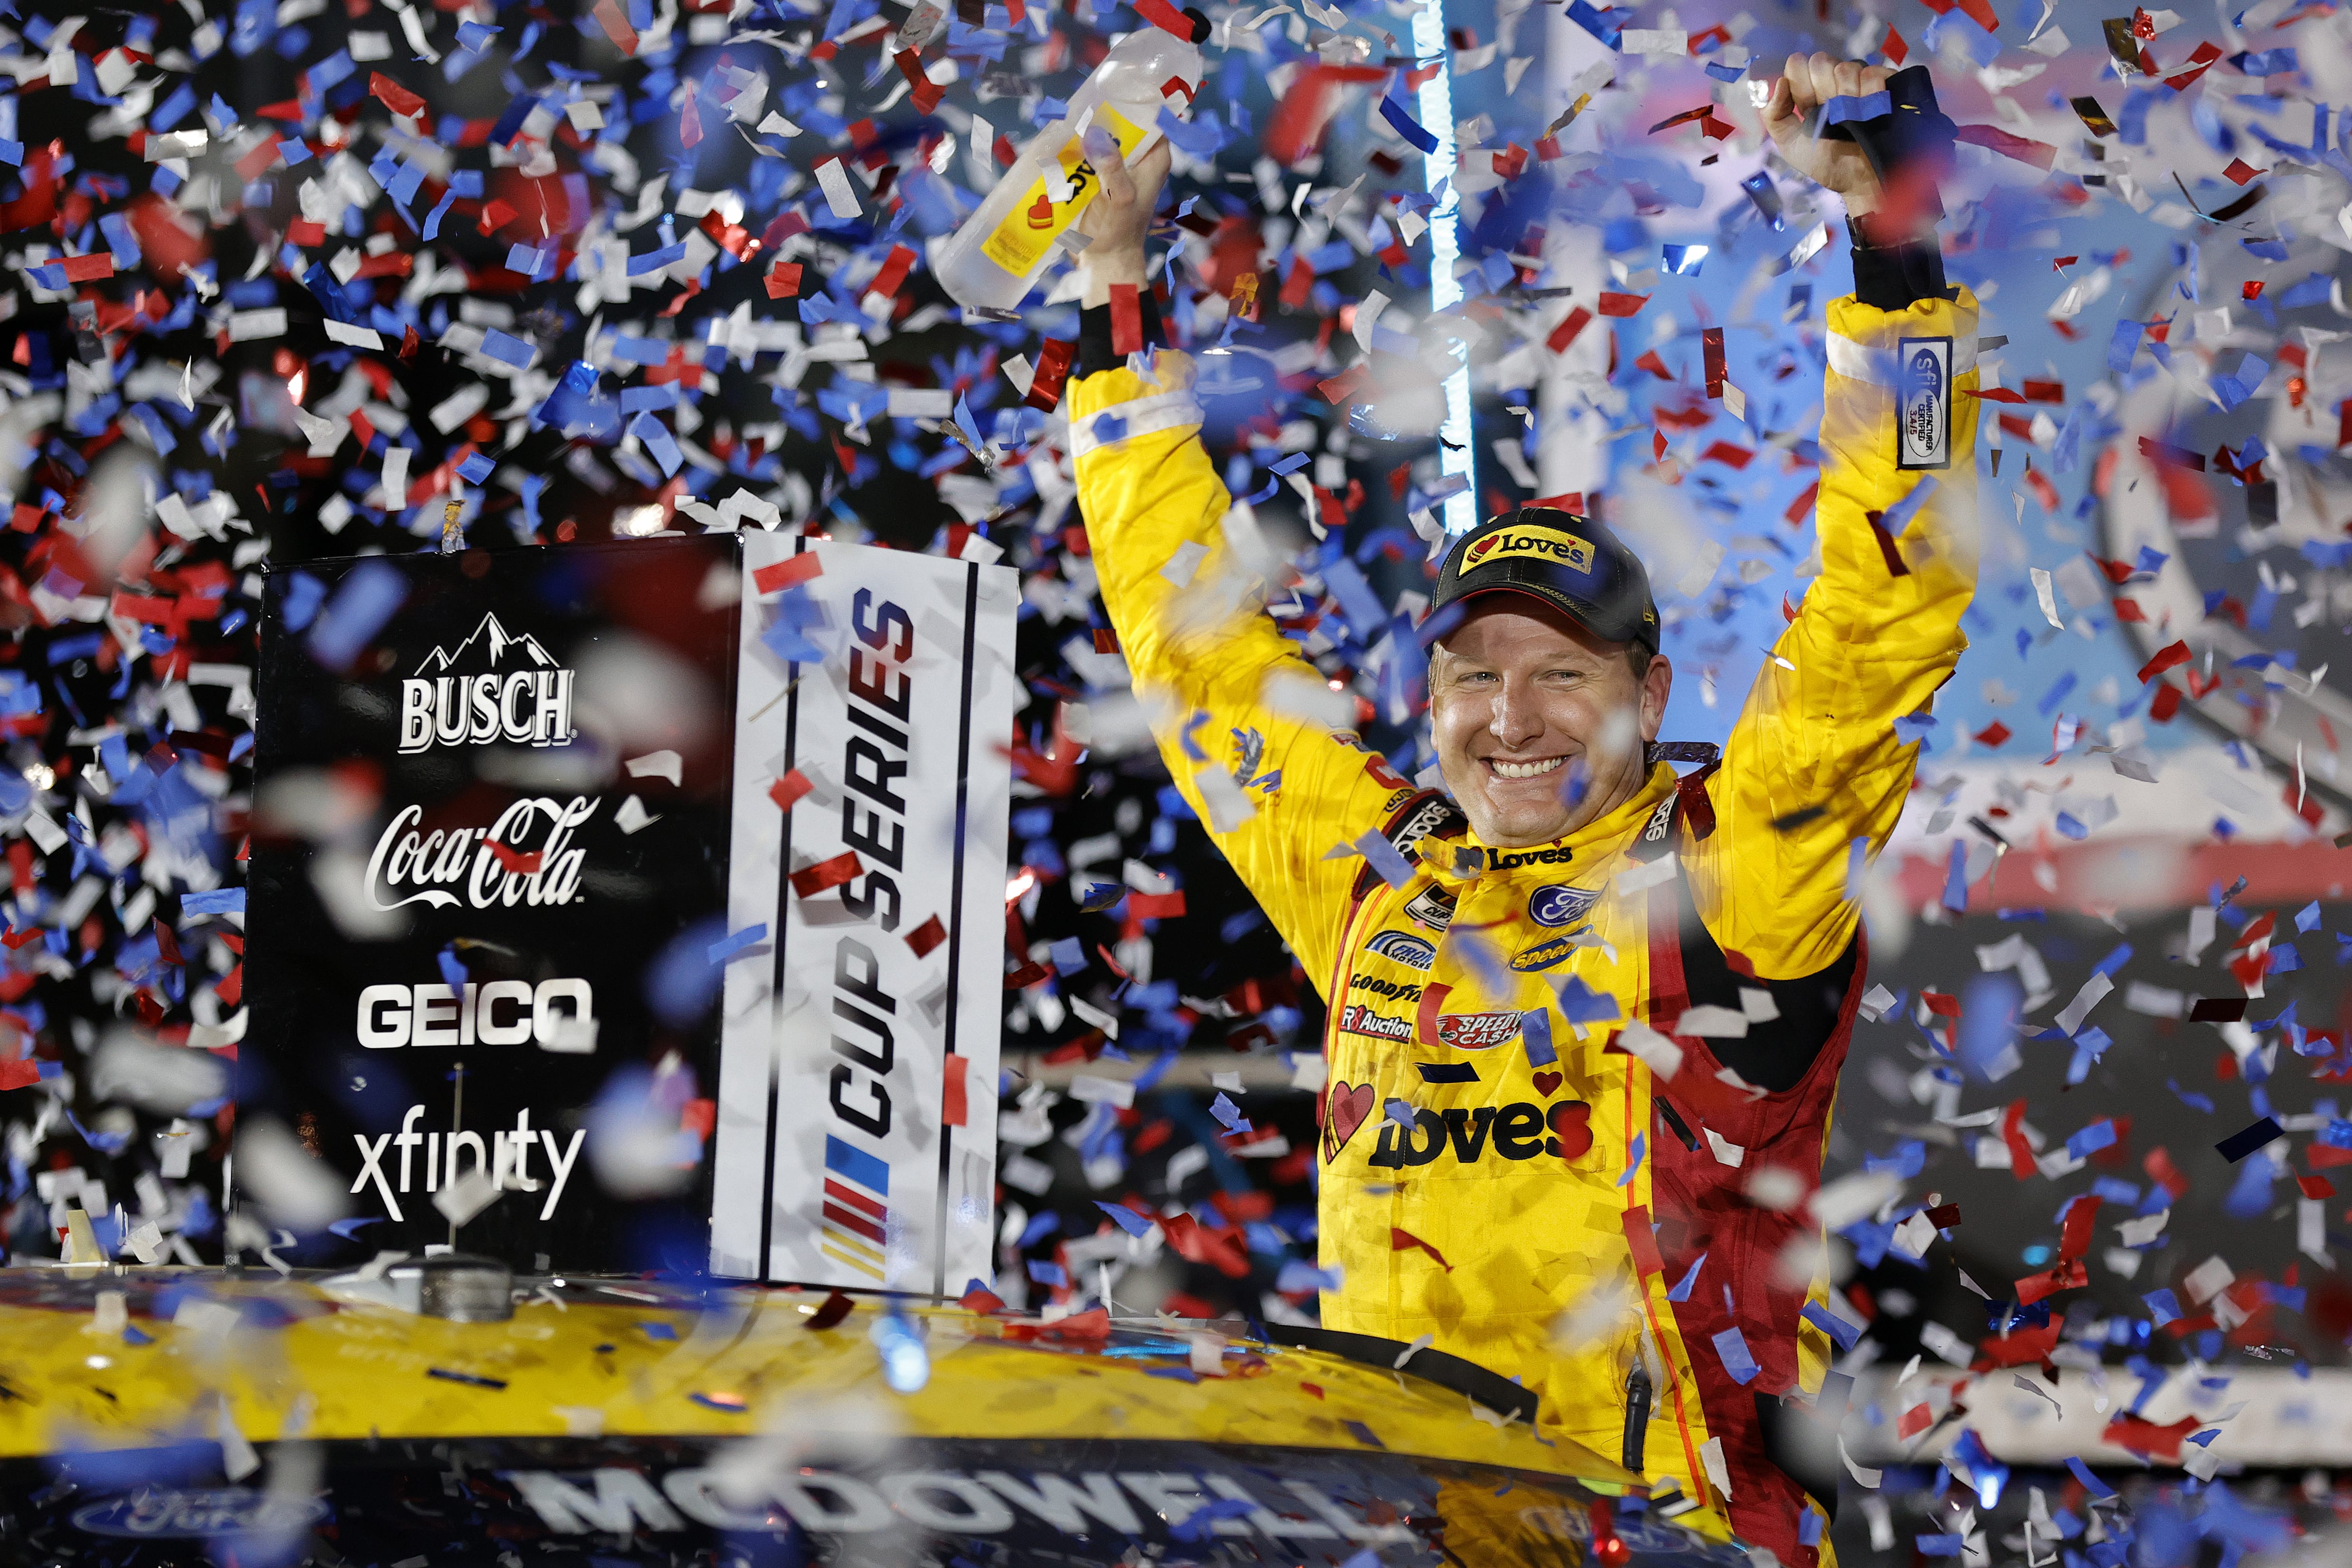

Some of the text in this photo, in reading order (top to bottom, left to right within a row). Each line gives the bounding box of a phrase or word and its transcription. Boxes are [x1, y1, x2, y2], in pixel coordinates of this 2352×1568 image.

[1916, 358, 1937, 386] sfi
[1925, 395, 1933, 450] MANUFACTURER
[397, 669, 575, 754] BUSCH
[1392, 801, 1452, 858] sparc
[829, 587, 914, 1139] CUP SERIES
[1424, 906, 1451, 919] CUP
[1391, 945, 1435, 963] FRON
[357, 978, 593, 1048] GEICO
[349, 1104, 587, 1221] xfinity
